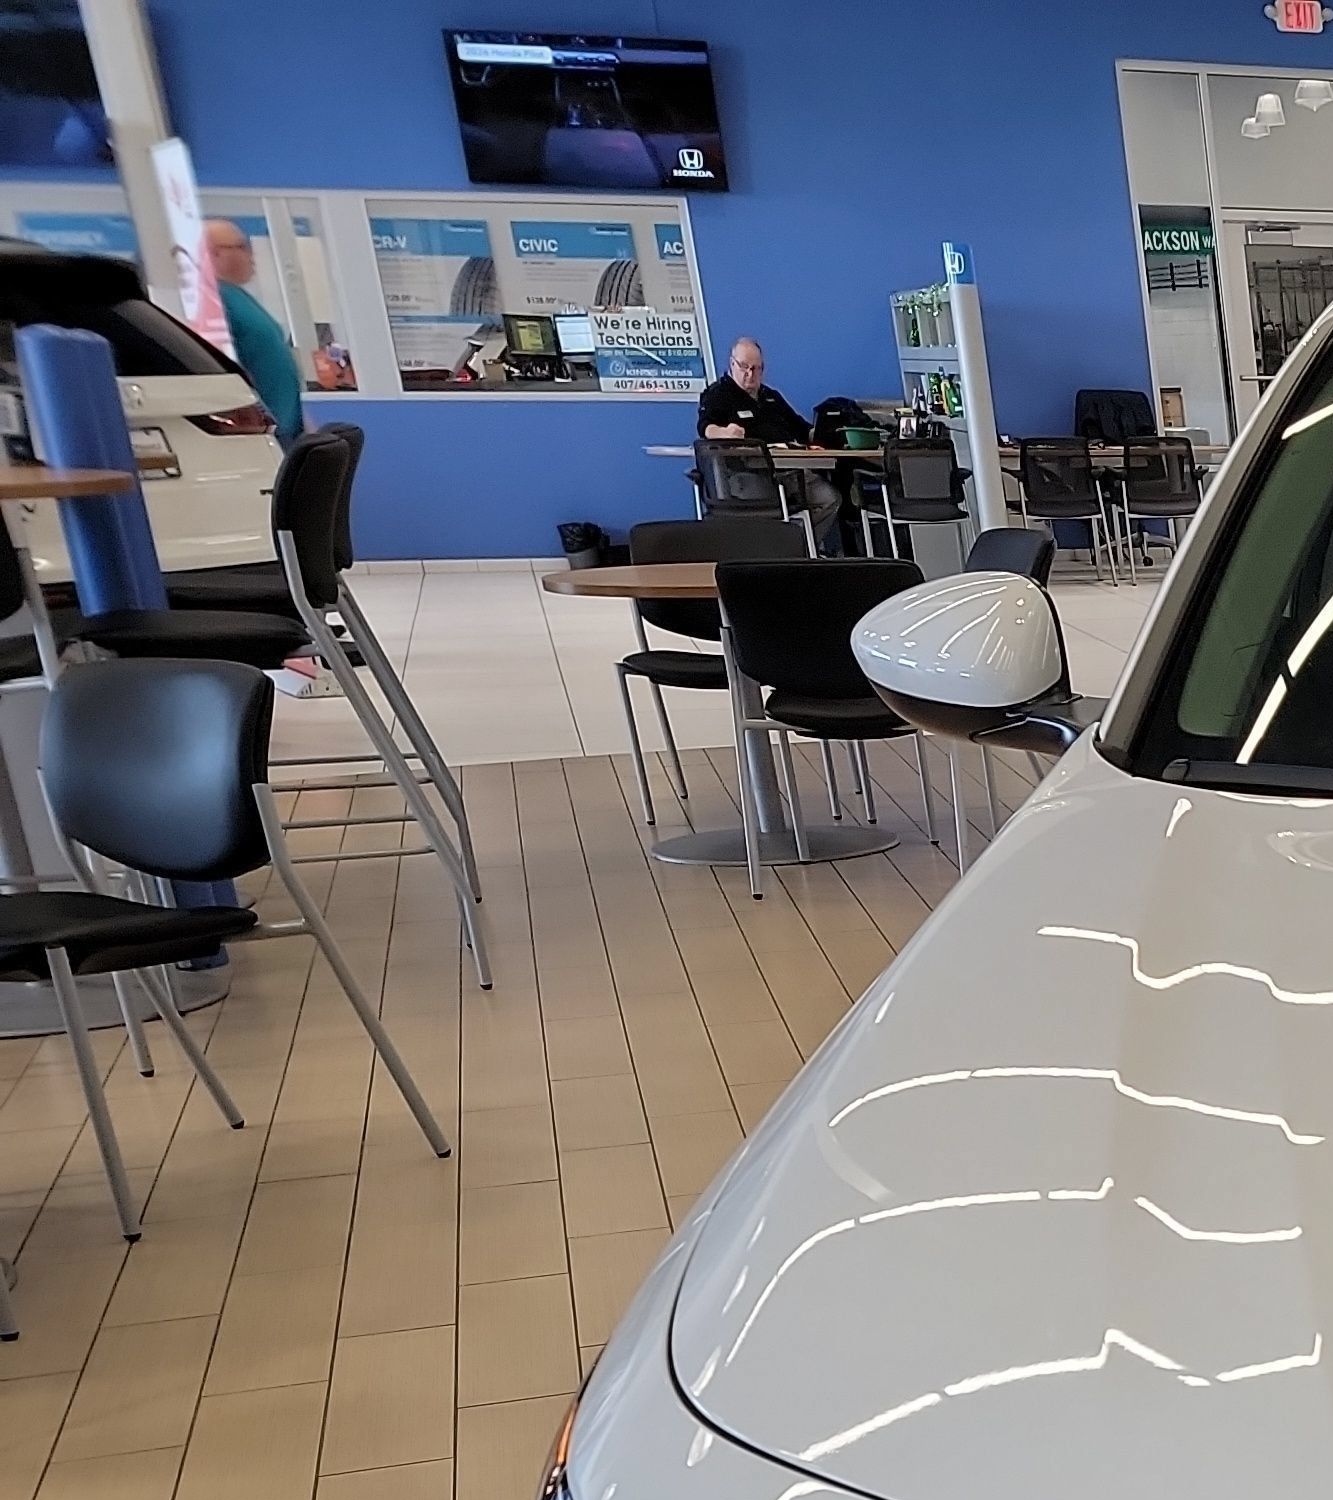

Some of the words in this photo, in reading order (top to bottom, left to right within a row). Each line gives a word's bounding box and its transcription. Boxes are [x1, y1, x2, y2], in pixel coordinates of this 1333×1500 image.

[1285, 2, 1315, 29] EXIT
[672, 169, 715, 178] HONDA
[519, 239, 558, 252] CIVIC
[594, 316, 641, 330] We're
[646, 316, 692, 334] Hiring
[598, 332, 693, 346] Technicians
